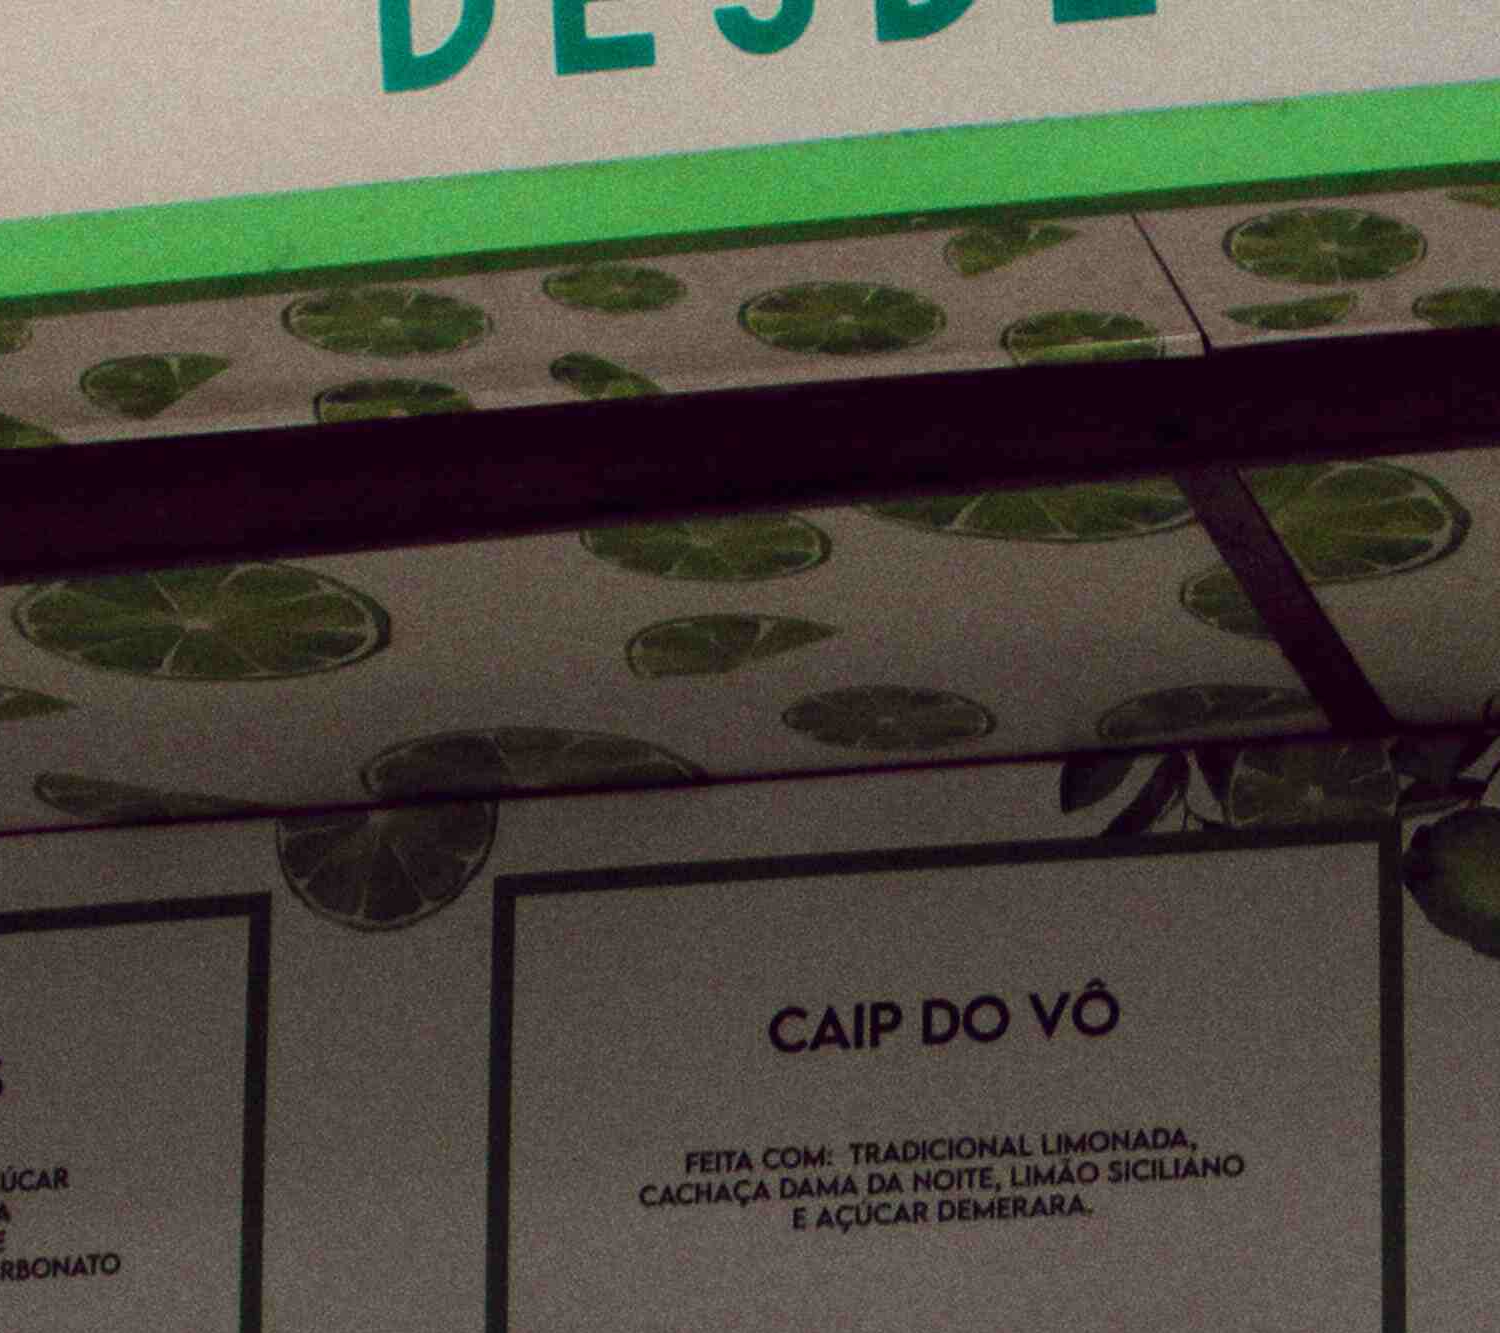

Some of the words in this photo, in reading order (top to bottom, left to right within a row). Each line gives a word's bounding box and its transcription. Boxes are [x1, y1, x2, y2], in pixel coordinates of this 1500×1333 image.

[767, 1000, 904, 1054] CAIP
[921, 993, 1011, 1047] DO
[1027, 978, 1121, 1039] VÔ
[684, 1149, 754, 1174] FEITA
[761, 1145, 833, 1171] COM:
[848, 1135, 1033, 1165] TRADICIONAL
[1040, 1127, 1198, 1156] LIMONADA,
[637, 1179, 771, 1209] CACHAÇA
[779, 1175, 858, 1201] DAMA
[867, 1173, 903, 1196] DA
[913, 1167, 1001, 1192] NOITE,
[1011, 1162, 1100, 1187] LIMÃO
[1107, 1152, 1247, 1185] SICILIANO
[791, 1206, 808, 1231] E
[815, 1201, 929, 1234] AÇÚCAR
